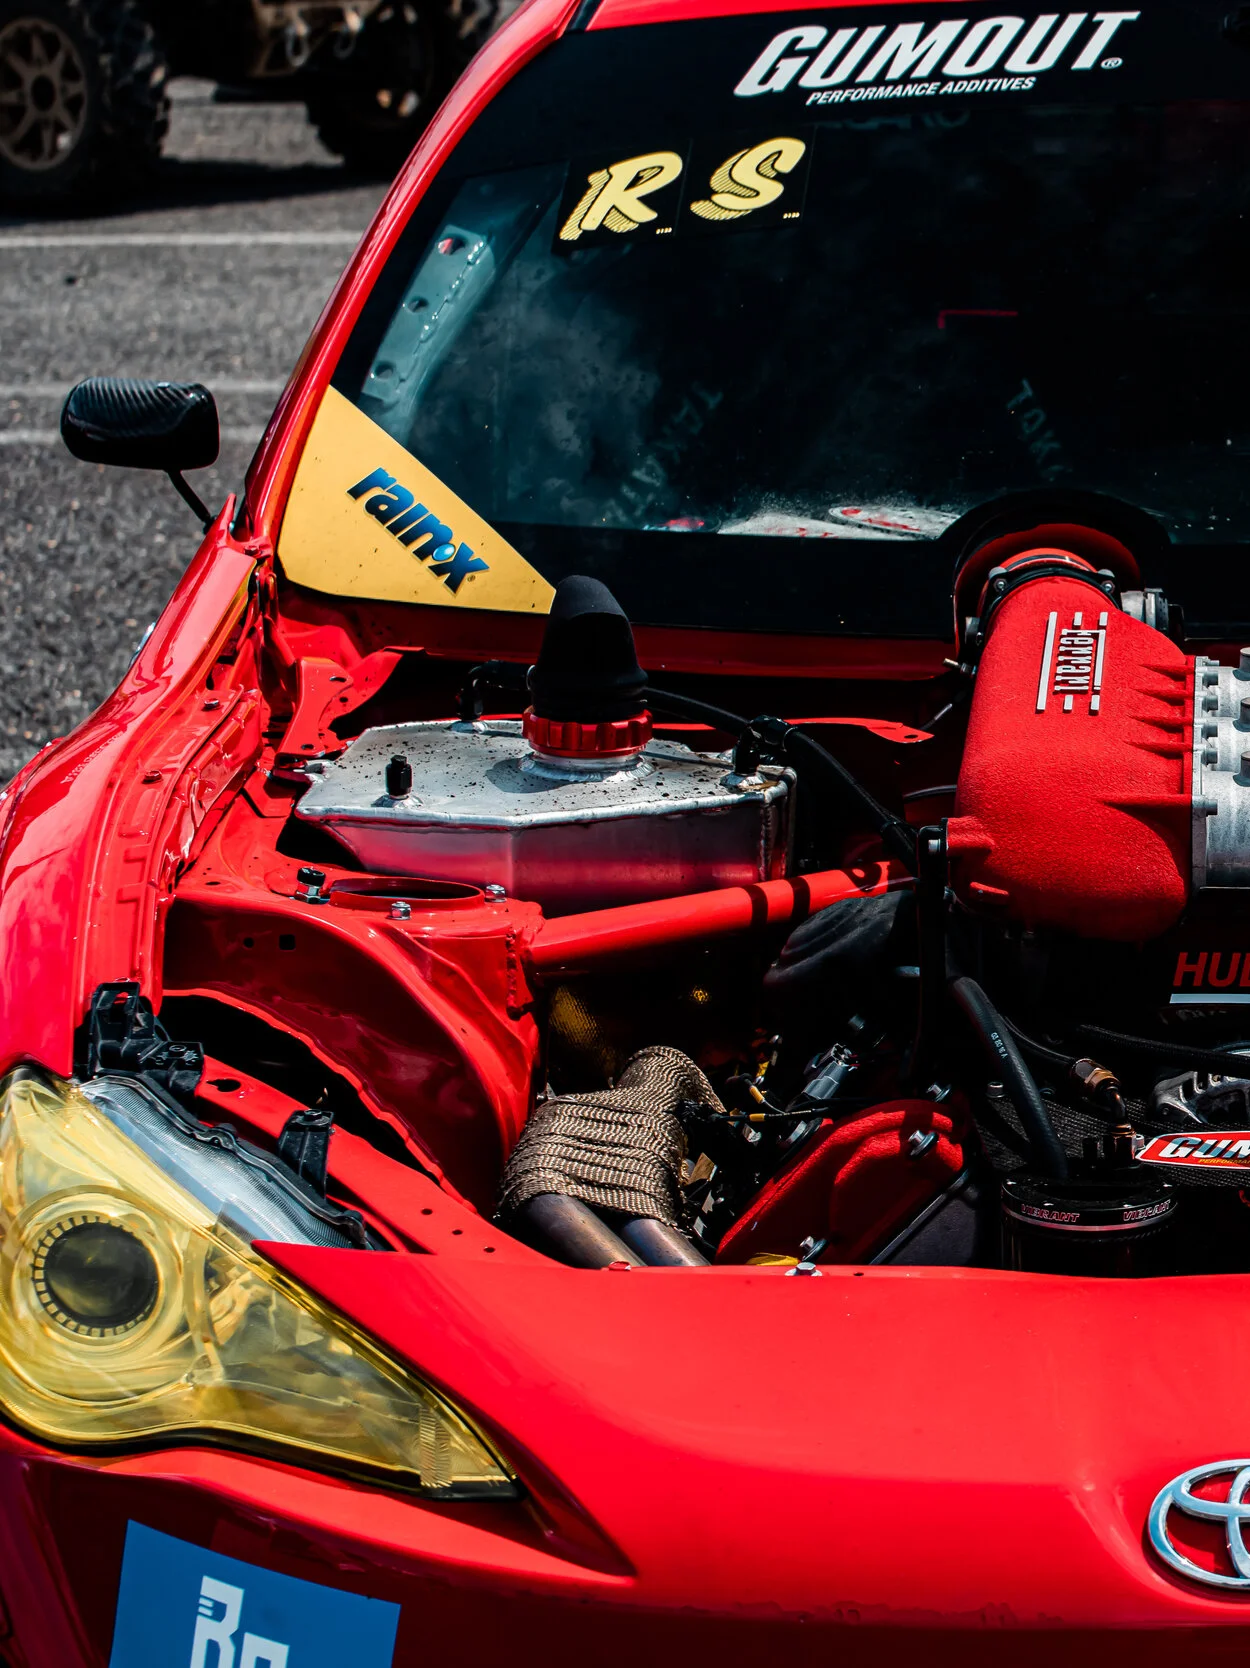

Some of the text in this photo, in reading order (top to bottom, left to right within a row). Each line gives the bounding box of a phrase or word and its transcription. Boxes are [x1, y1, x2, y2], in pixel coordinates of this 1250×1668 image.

[805, 76, 1037, 106] PERFORMANCE ADDITIVES
[1020, 1203, 1080, 1223] VIBRANT
